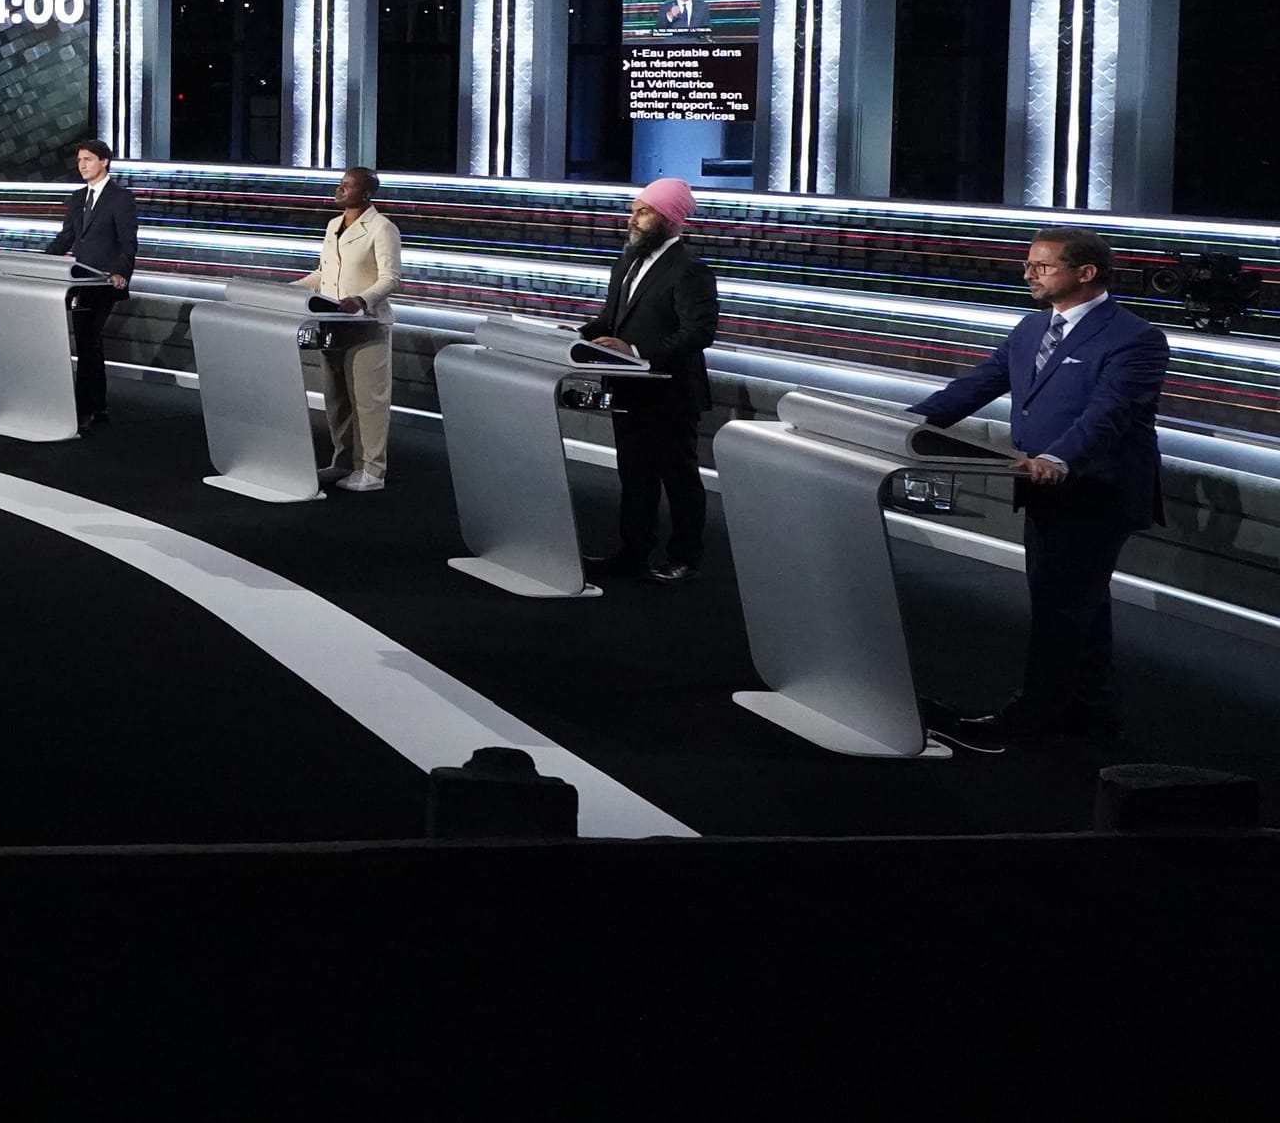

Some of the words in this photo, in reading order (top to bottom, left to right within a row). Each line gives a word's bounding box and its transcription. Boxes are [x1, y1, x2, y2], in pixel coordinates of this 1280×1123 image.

[631, 48, 665, 58] 1-Eau
[666, 48, 710, 60] potable
[711, 48, 742, 57] dans
[630, 59, 648, 68] les
[649, 59, 699, 68] réserves
[630, 79, 645, 89] La
[646, 79, 715, 89] Vérificatrice
[629, 89, 680, 100] générale
[688, 90, 718, 100] dans
[719, 91, 743, 100] son
[629, 100, 670, 109] dernier
[629, 110, 665, 120] efforts
[666, 110, 683, 120] de
[684, 110, 736, 121] Services
